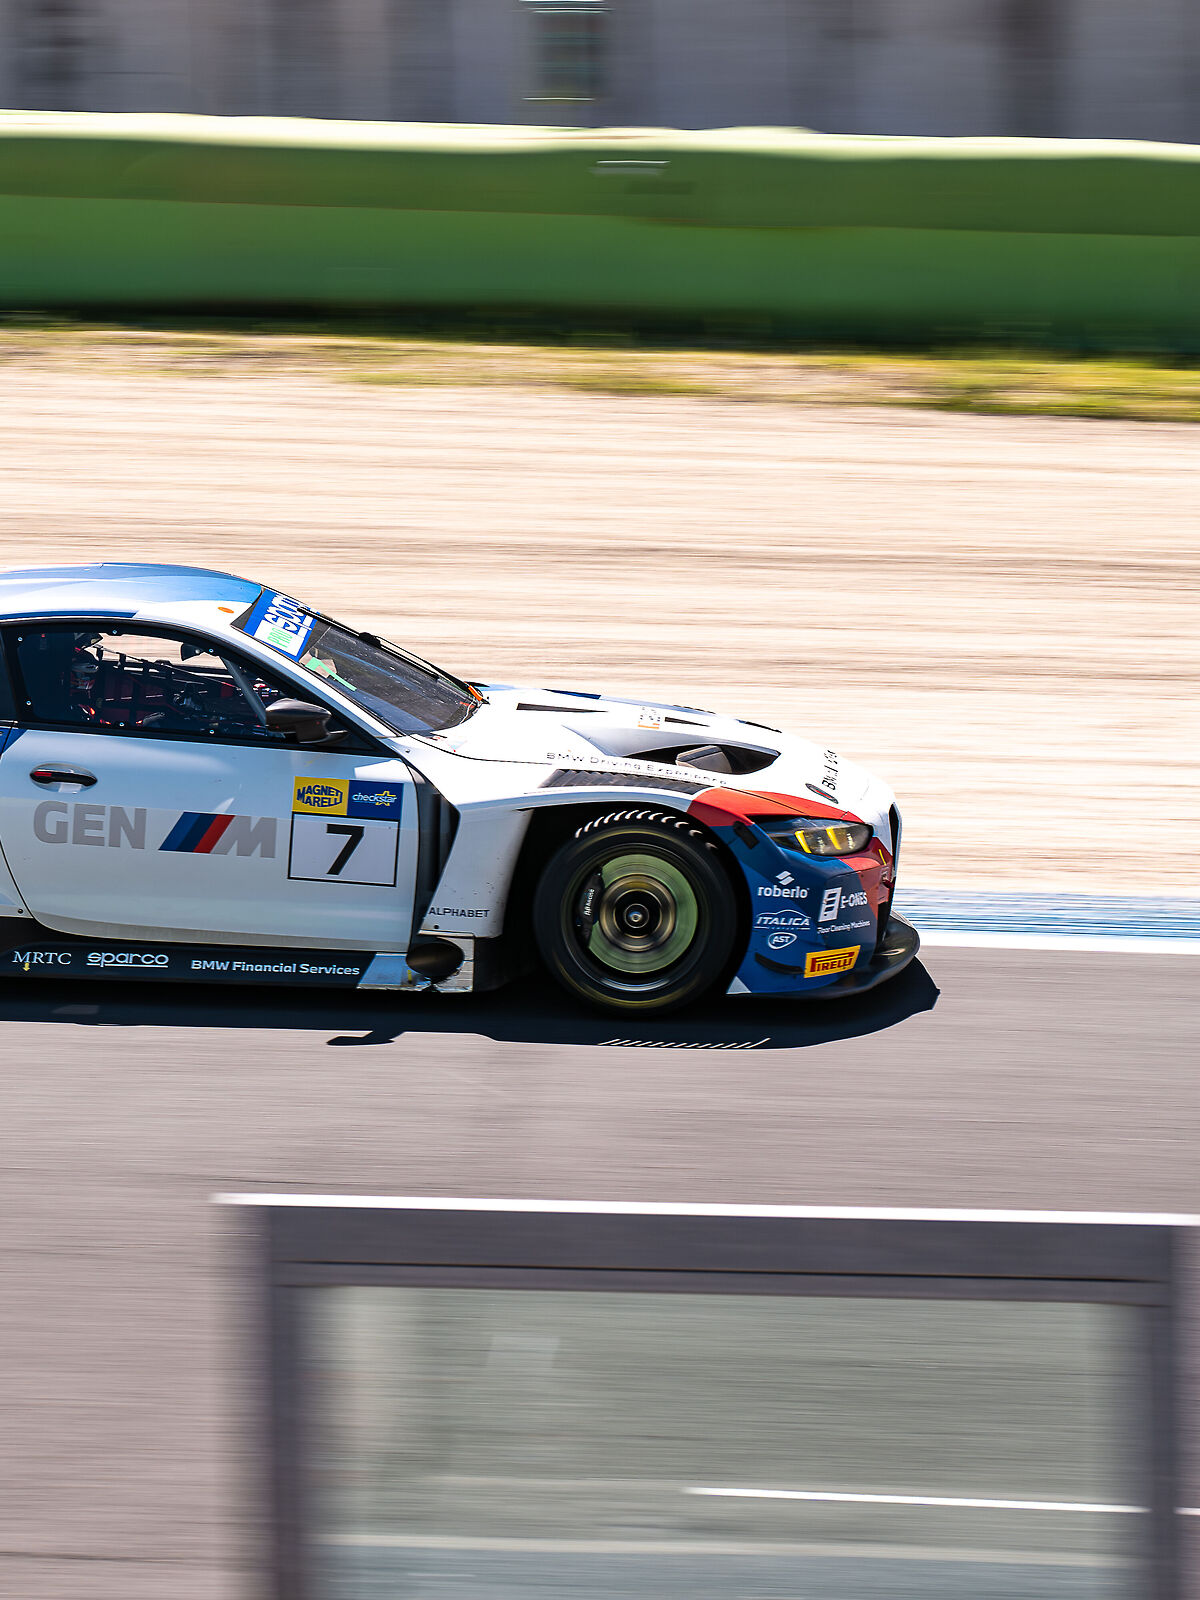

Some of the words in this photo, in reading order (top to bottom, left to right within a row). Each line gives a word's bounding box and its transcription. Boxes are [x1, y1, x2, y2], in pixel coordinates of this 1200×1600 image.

[351, 792, 398, 804] checkstar
[33, 800, 147, 850] GEN
[209, 814, 278, 859] M
[326, 823, 365, 876] 7
[757, 884, 809, 899] roberlo
[840, 891, 869, 909] E-ONES
[428, 906, 491, 918] ALPHABET
[756, 916, 811, 926] ITALICA
[772, 935, 791, 945] AST
[11, 951, 72, 965] MRTC
[87, 952, 169, 968] sparco
[809, 951, 855, 973] PIRELLI
[191, 959, 230, 971] BMW
[232, 961, 297, 973] Financial
[299, 963, 360, 975] Services
